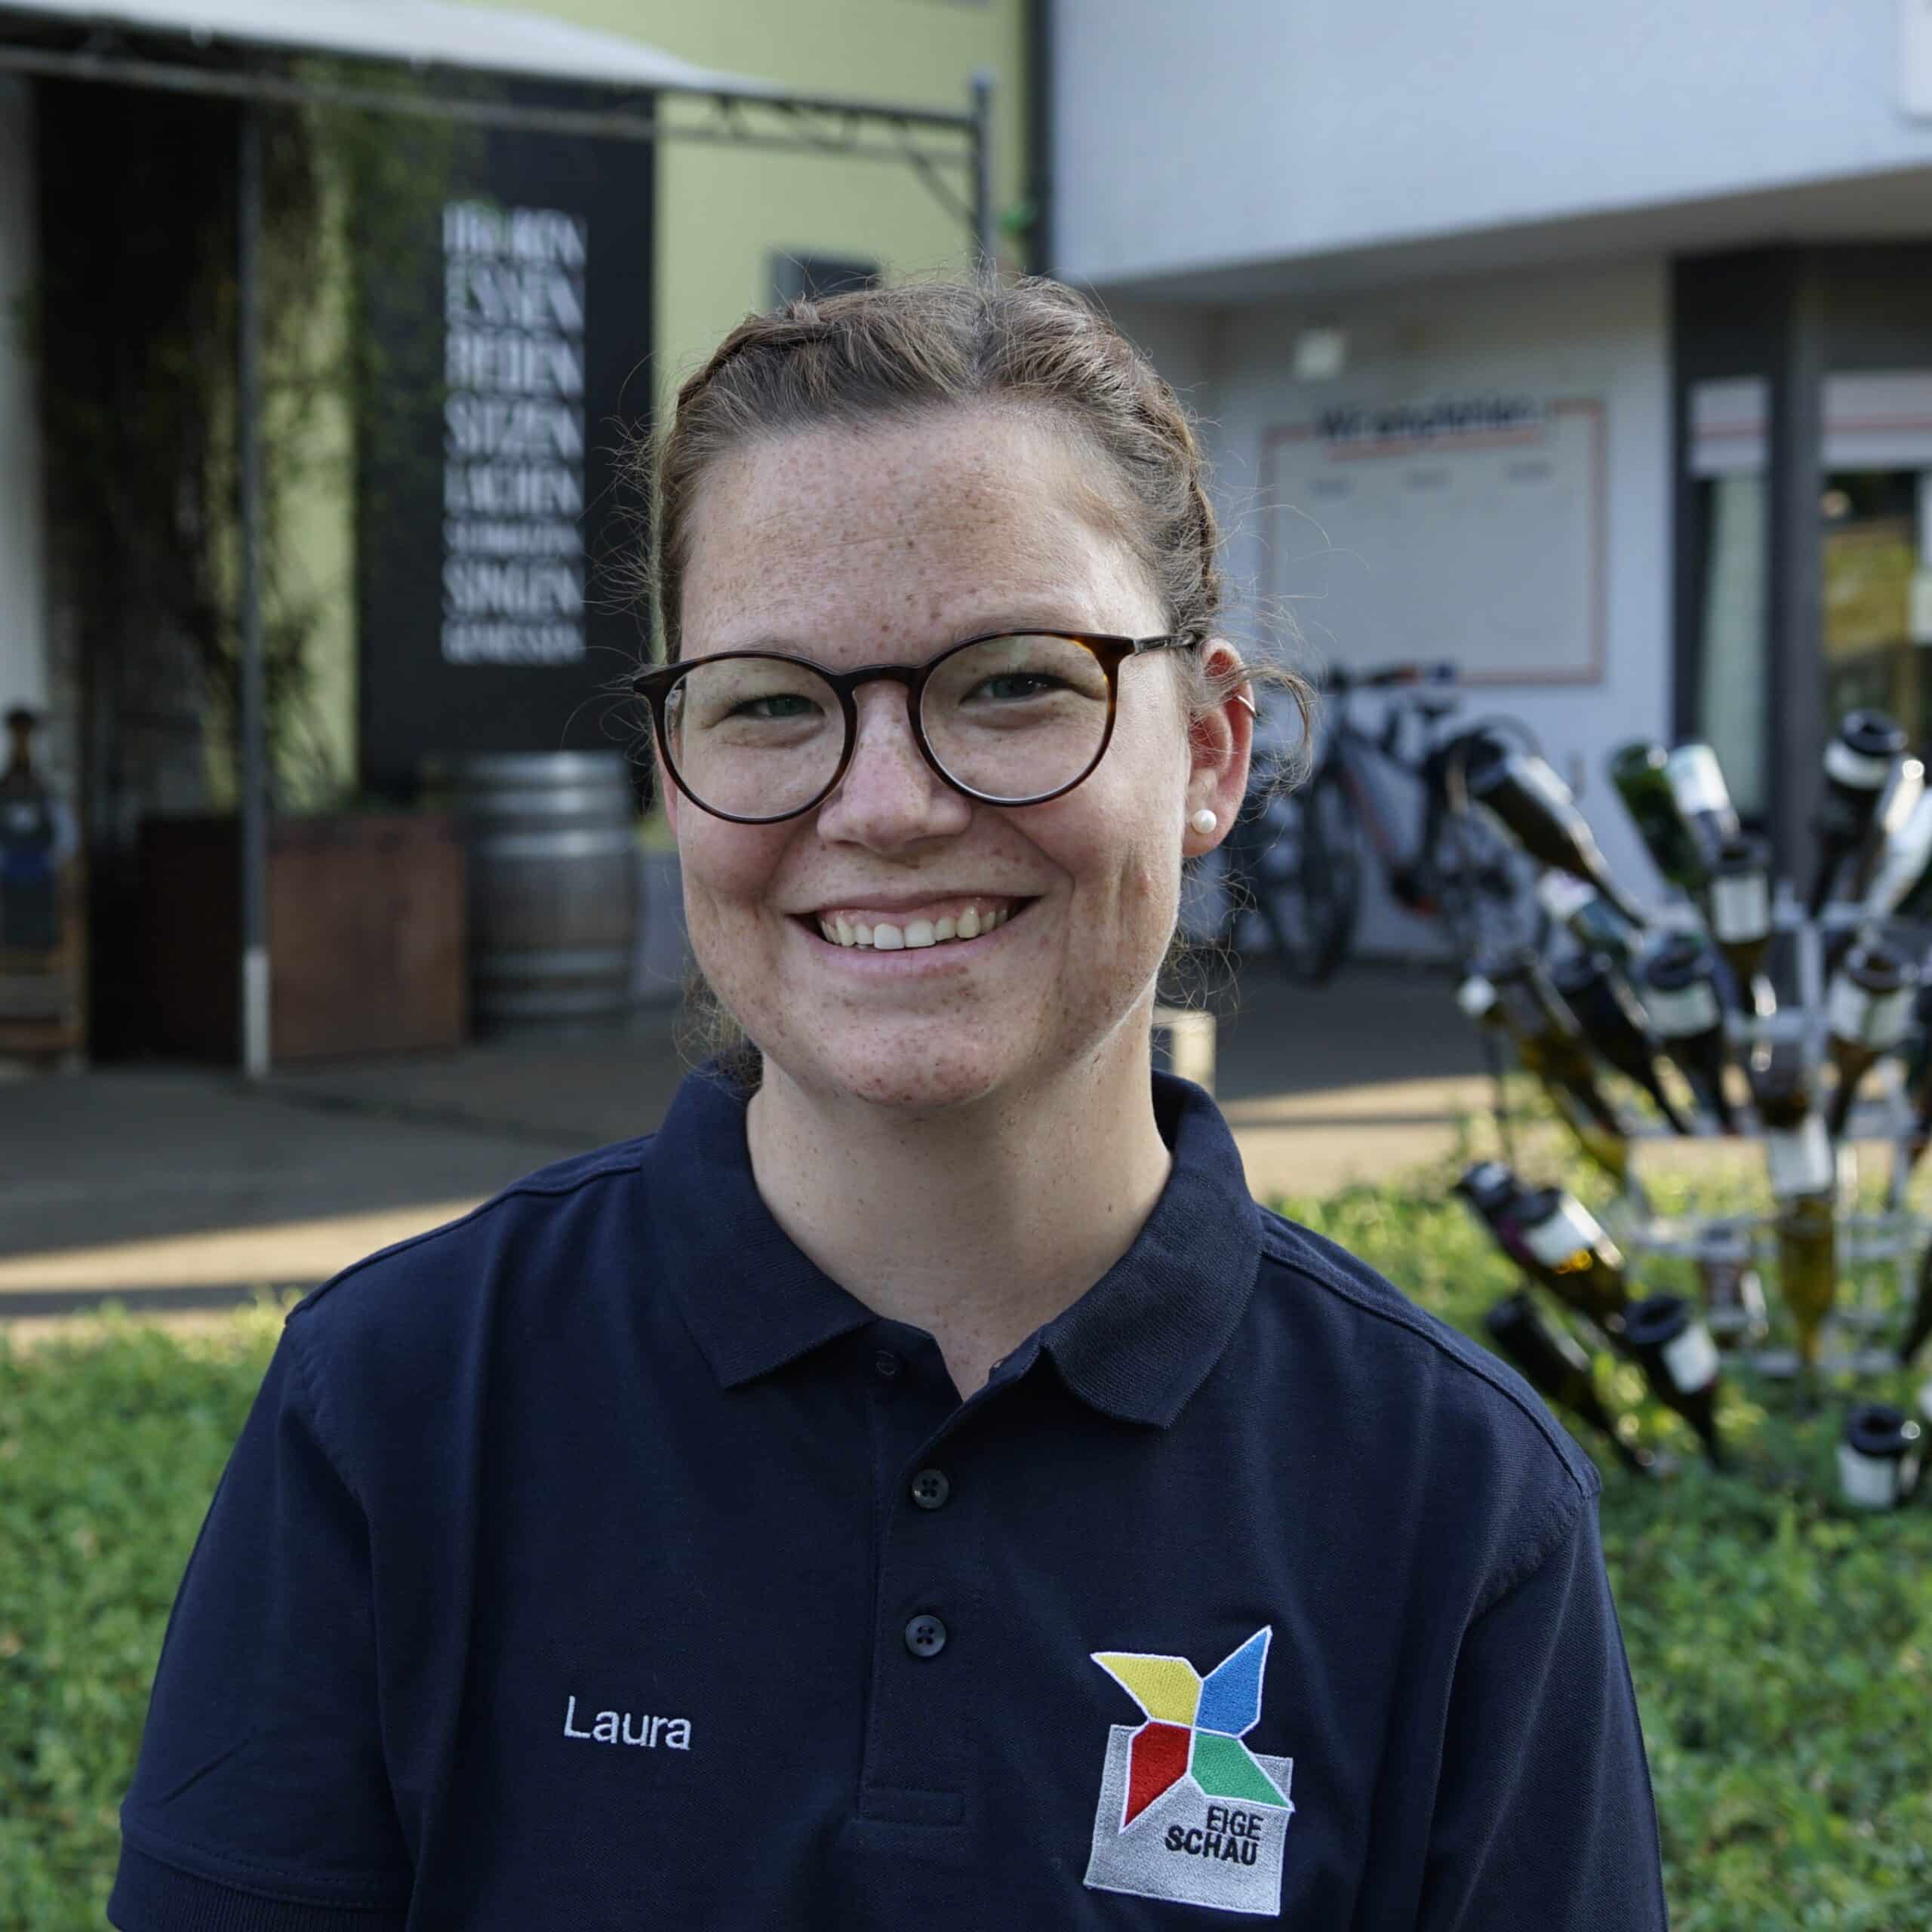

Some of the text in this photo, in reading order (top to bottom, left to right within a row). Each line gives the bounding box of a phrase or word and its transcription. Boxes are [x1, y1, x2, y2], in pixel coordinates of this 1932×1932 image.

[564, 1695, 691, 1751] Laura
[1206, 1804, 1263, 1841] EIGE
[1164, 1824, 1259, 1866] SCHAU
